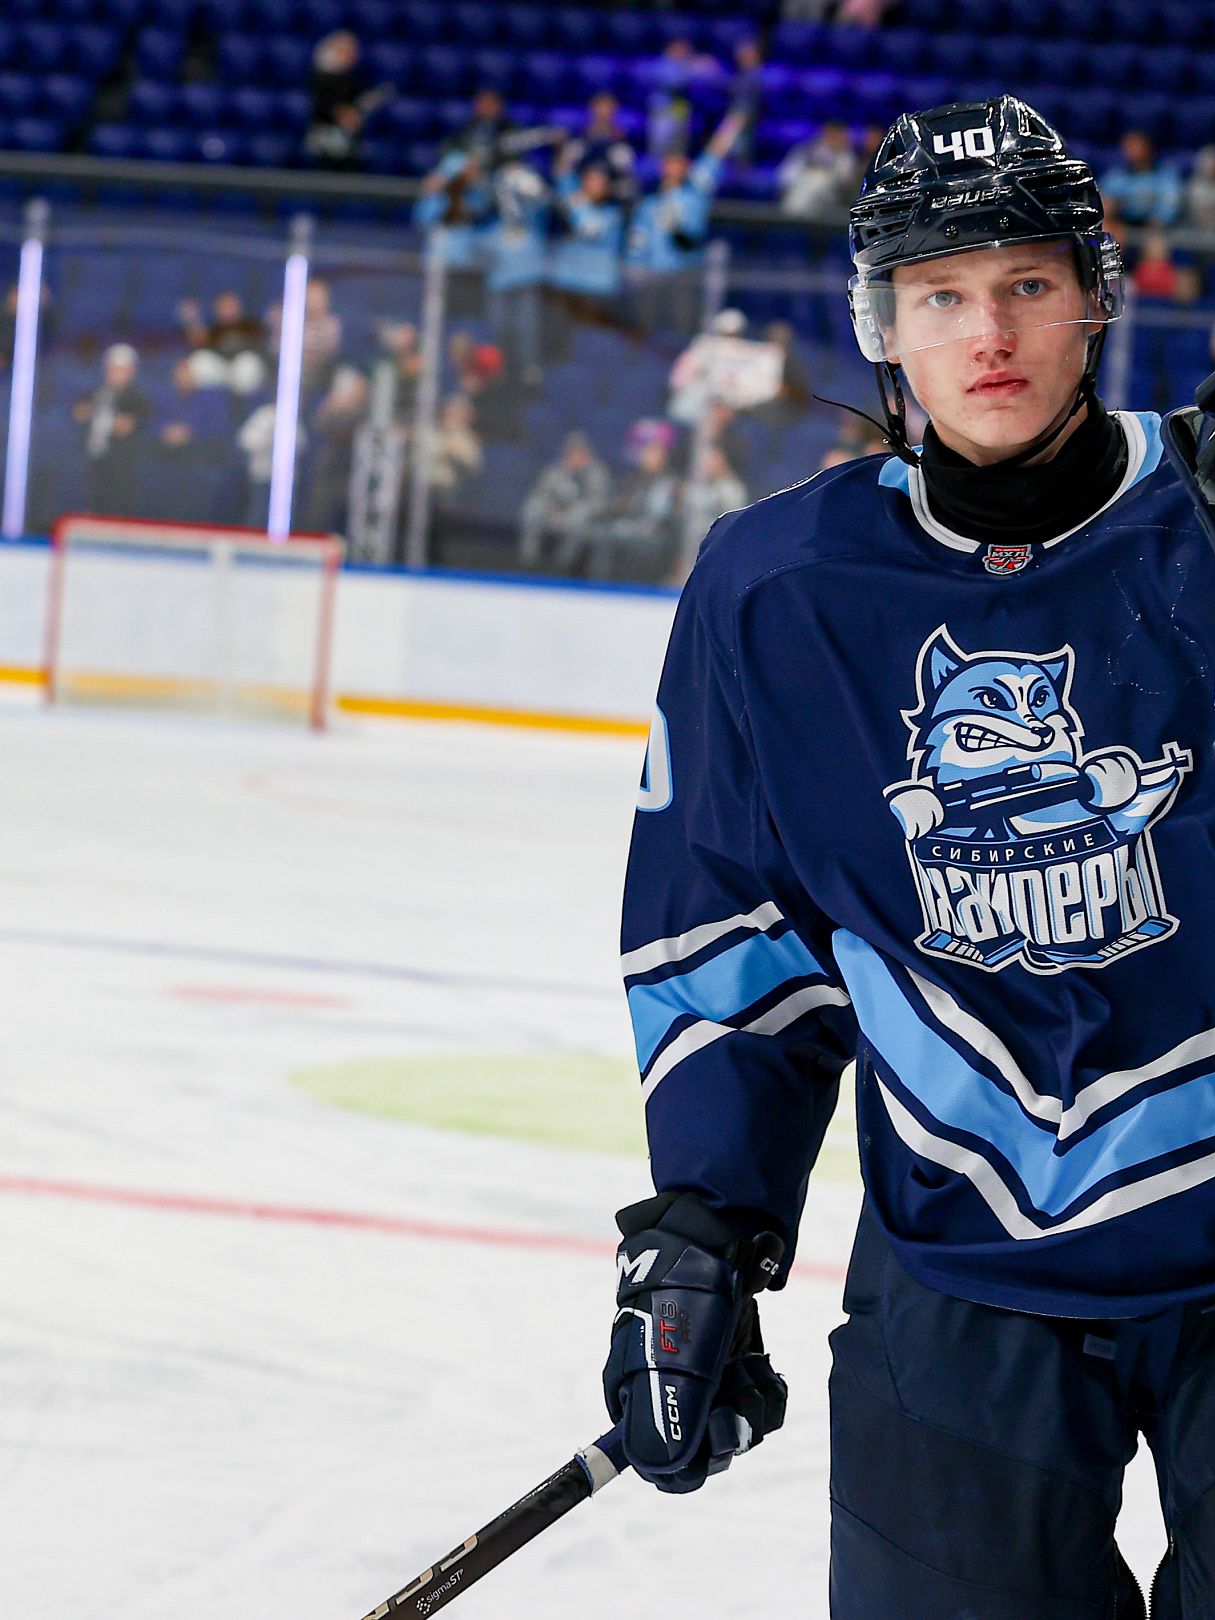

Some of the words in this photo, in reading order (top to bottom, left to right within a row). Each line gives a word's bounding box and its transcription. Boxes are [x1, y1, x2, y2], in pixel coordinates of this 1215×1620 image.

[932, 126, 996, 161] 40
[931, 833, 1095, 863] СИБИРСКИЕ
[659, 1300, 680, 1353] FT8
[665, 1384, 682, 1441] CCM
